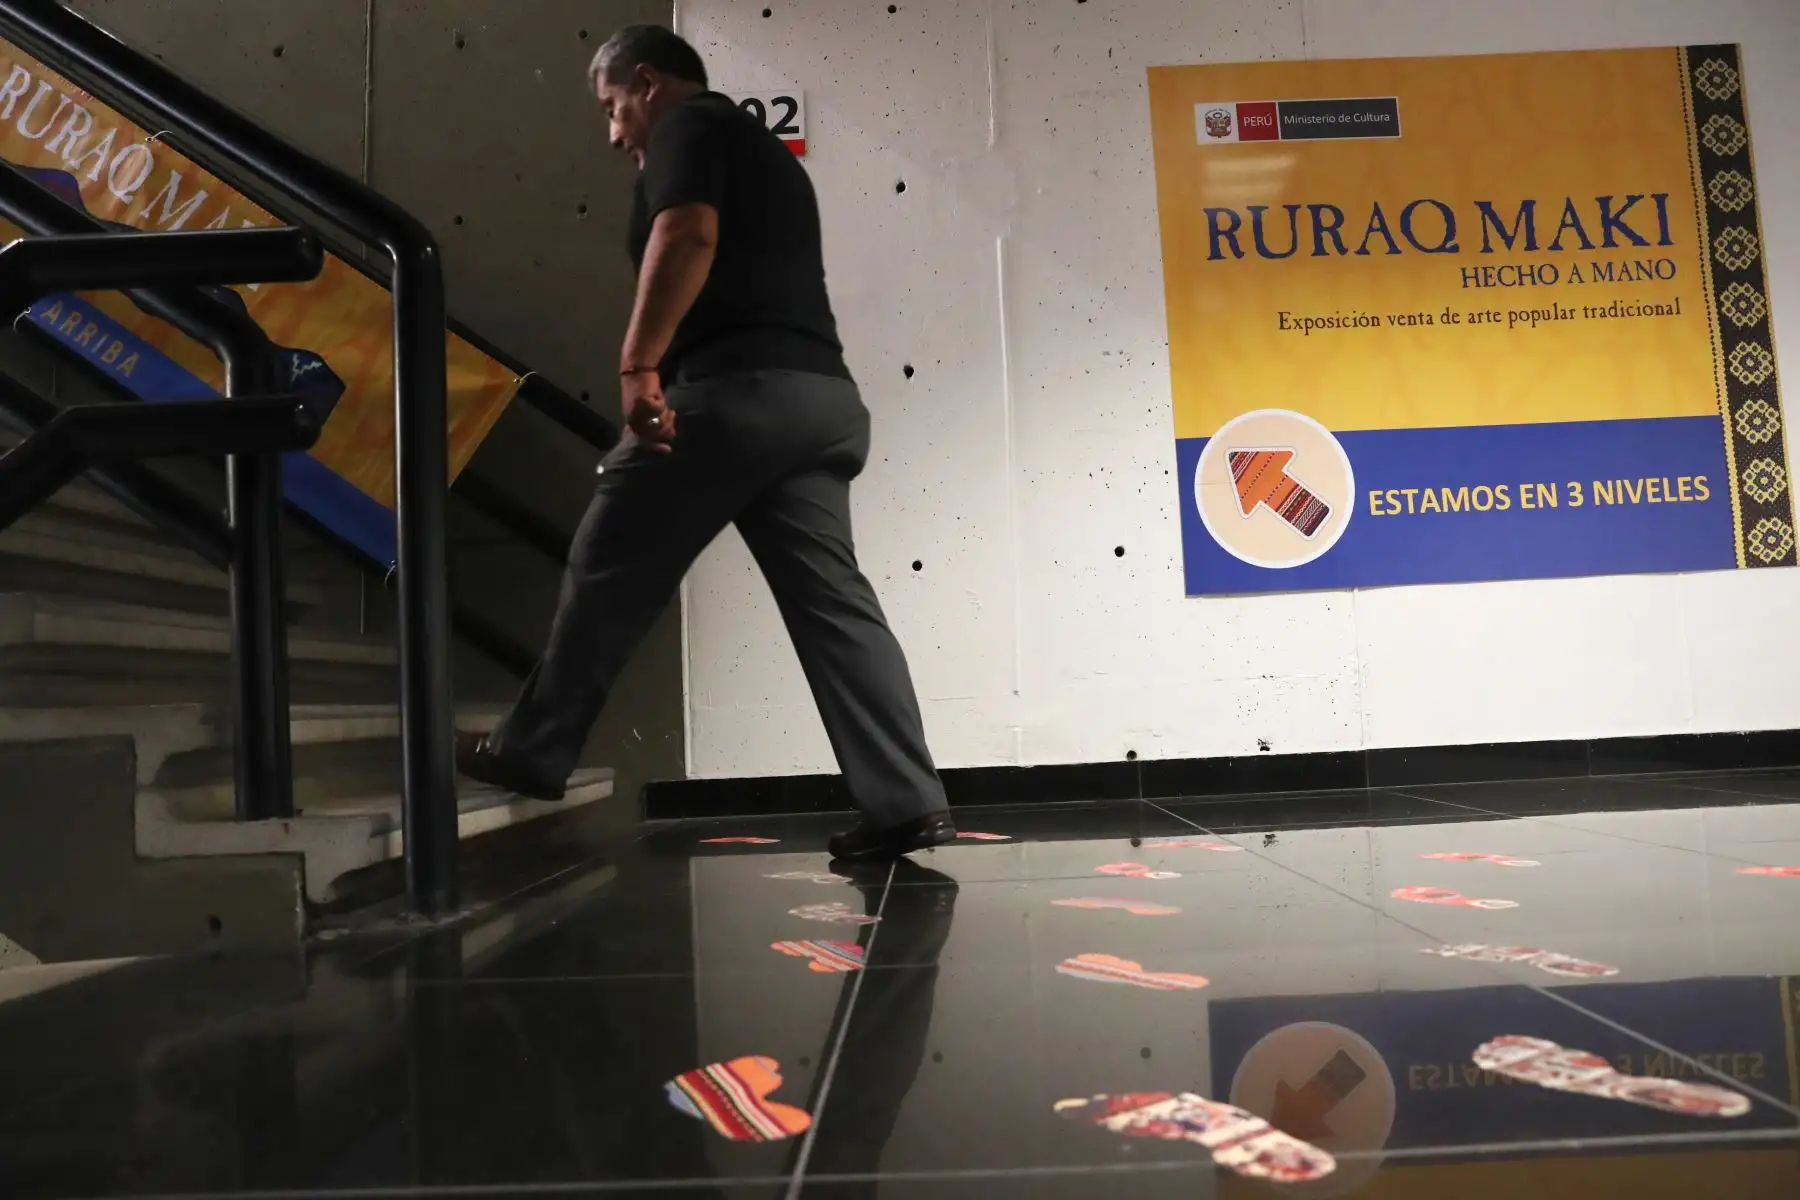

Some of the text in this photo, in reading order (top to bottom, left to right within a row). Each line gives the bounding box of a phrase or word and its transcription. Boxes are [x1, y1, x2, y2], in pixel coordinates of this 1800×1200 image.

[0, 64, 153, 203] RURAQ
[1243, 114, 1273, 127] PERÚ
[1284, 113, 1390, 125] Ministerio de Cultura
[1203, 193, 1675, 261] RURAQ MAKI
[1461, 258, 1676, 289] HECHO A MANO
[1278, 297, 1682, 335] Exposición venta de arte popular tradicional
[41, 301, 141, 378] ARRIBA
[1368, 475, 1711, 516] ESTAMOS EN 3 NIVELES
